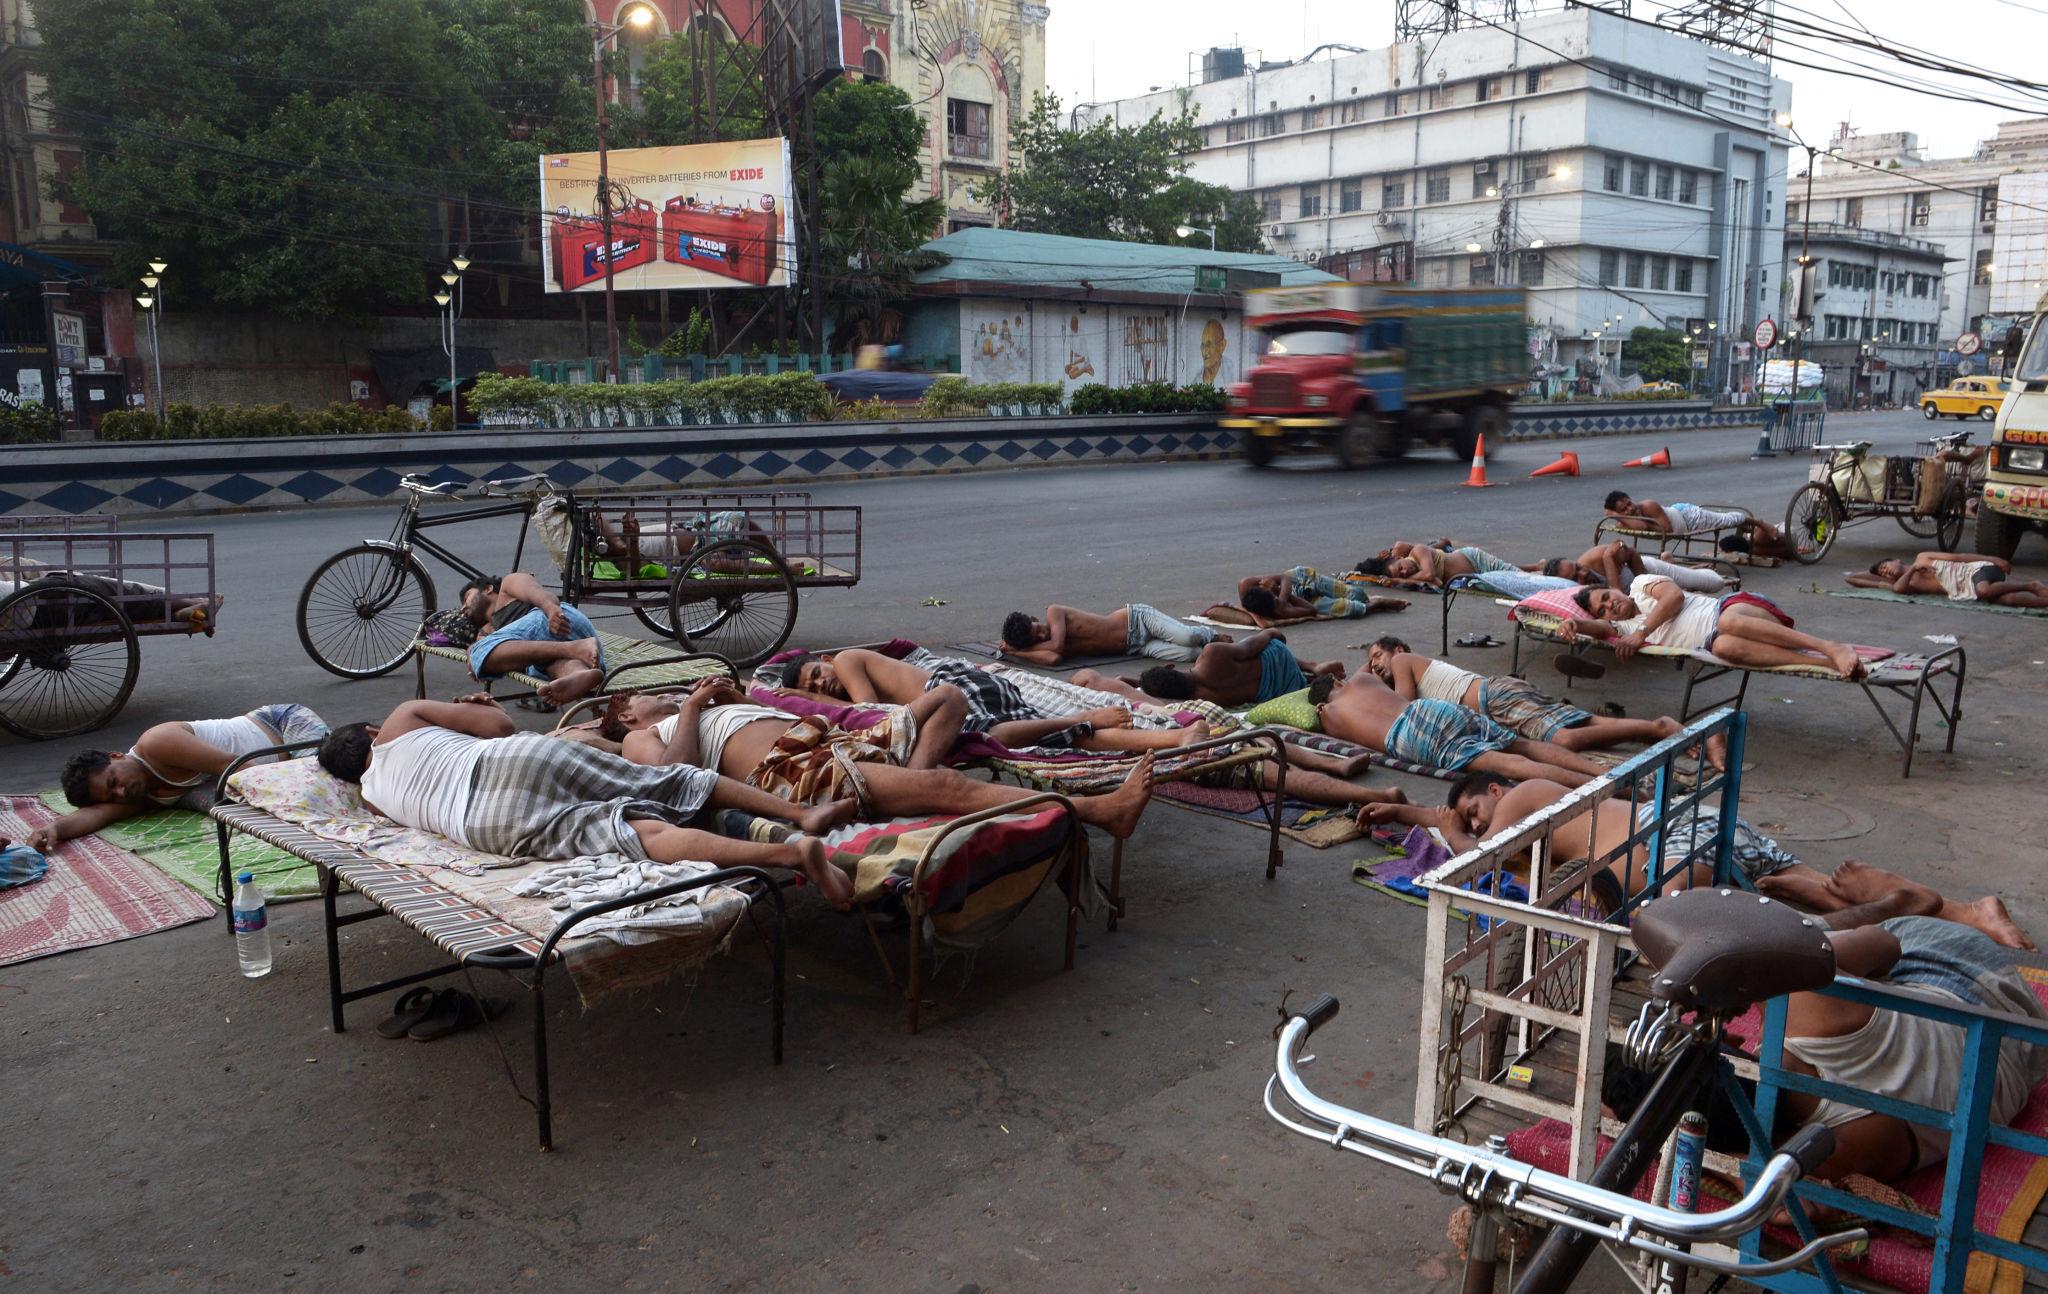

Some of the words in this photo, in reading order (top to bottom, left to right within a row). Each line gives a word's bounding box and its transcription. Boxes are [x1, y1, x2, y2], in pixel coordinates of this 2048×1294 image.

[560, 177, 617, 189] BEST-IN-CSS
[619, 174, 657, 186] INVERTER
[658, 172, 702, 183] BATTERIES
[703, 170, 728, 180] FROM
[729, 168, 764, 181] EXIDE
[596, 240, 624, 256] EDE
[692, 237, 727, 252] EXIDE
